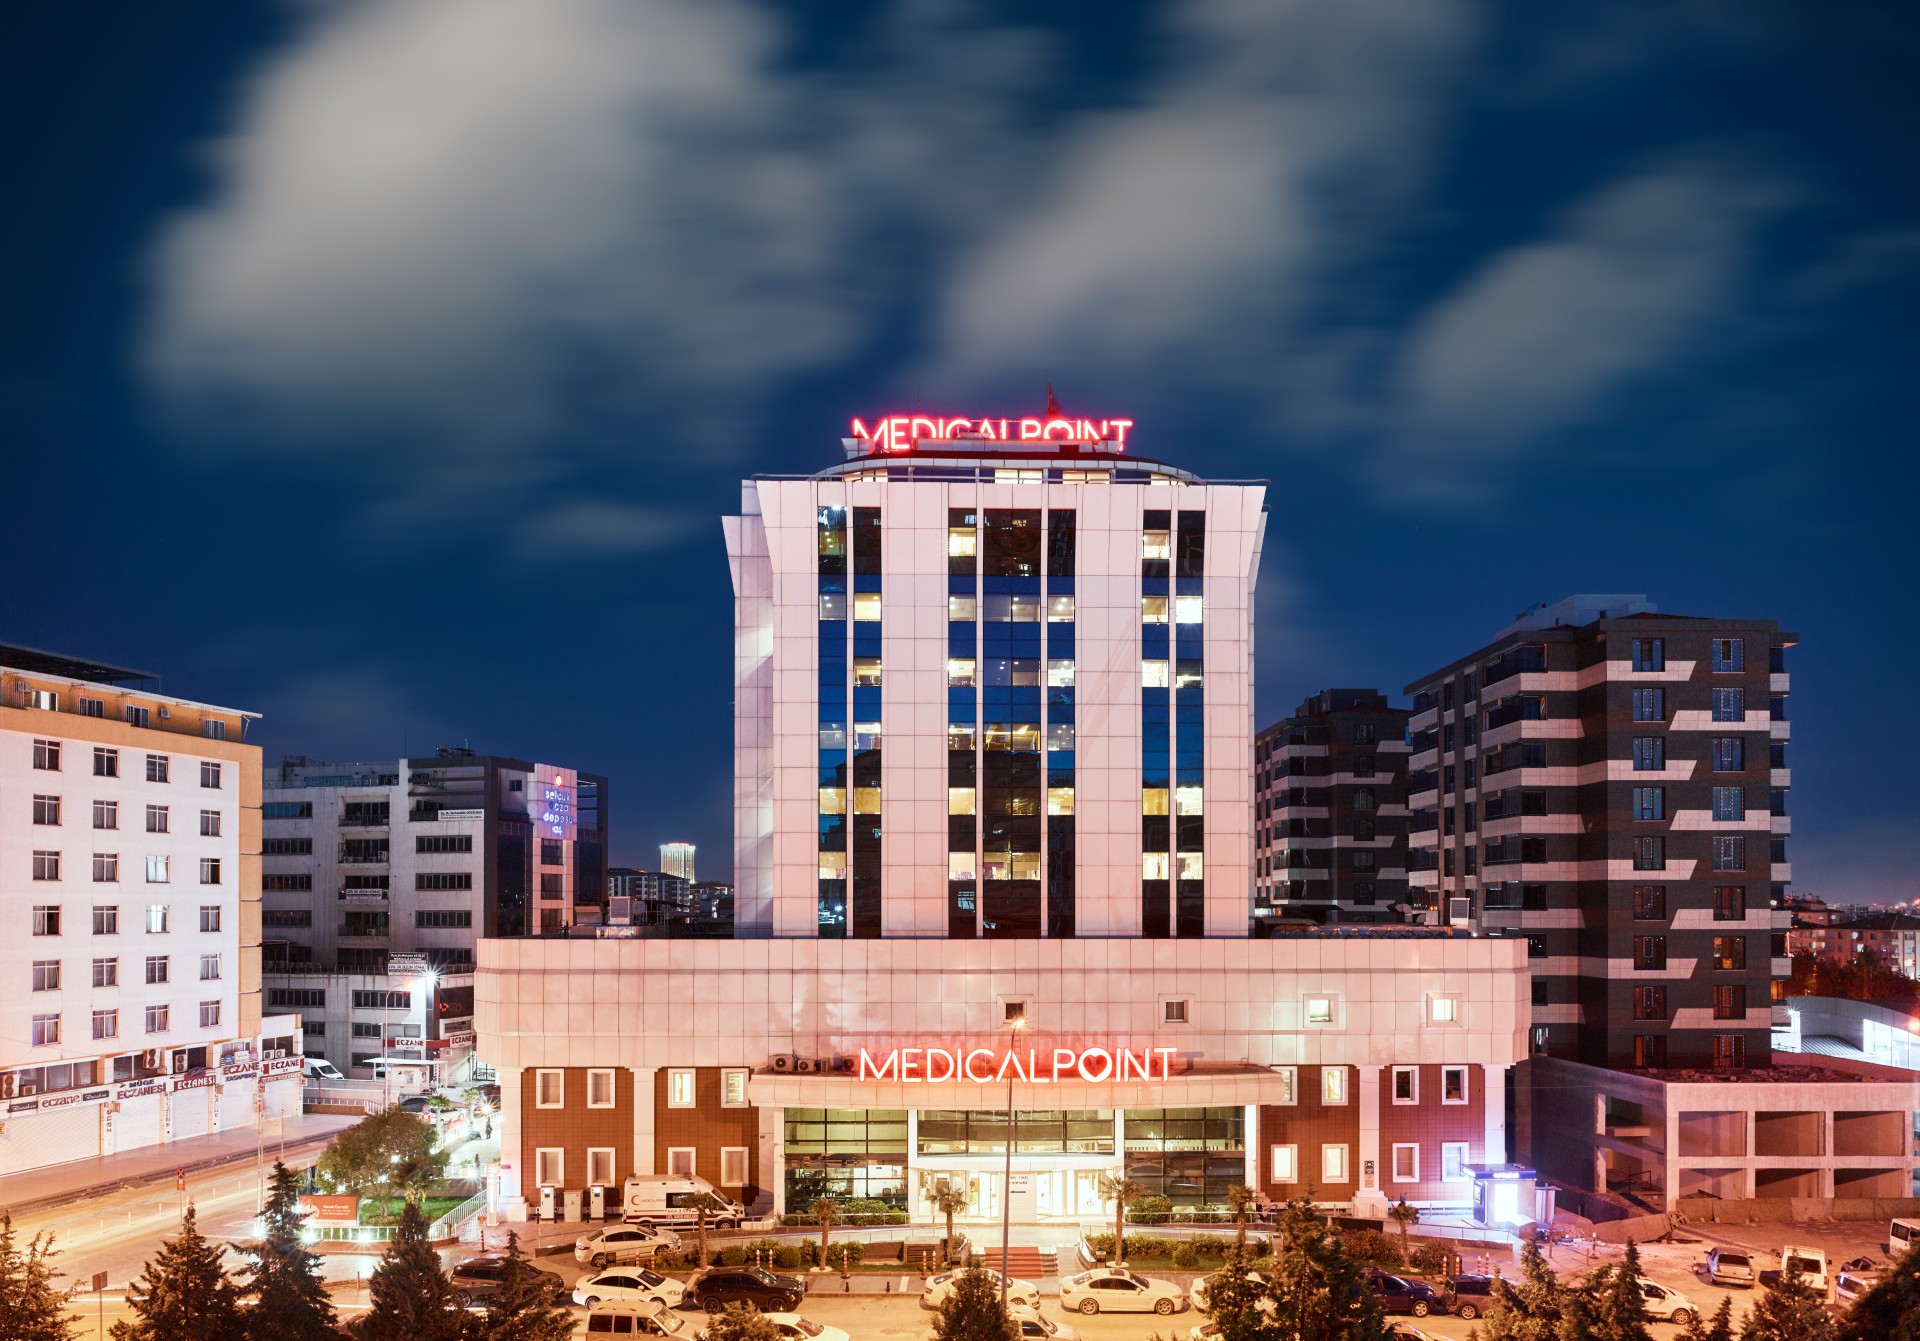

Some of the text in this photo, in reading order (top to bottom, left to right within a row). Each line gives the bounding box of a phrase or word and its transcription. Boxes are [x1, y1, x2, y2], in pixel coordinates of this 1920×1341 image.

[853, 417, 1134, 451] MEDICALPOINT
[545, 790, 571, 802] selçuk
[543, 811, 573, 824] deposu
[452, 1036, 472, 1044] ECZANE
[223, 1062, 259, 1076] ECZANE
[270, 1059, 300, 1070] ECZANE
[859, 1047, 1178, 1084] MEDICALPOINT
[129, 1079, 154, 1087] MÜGE
[41, 1094, 81, 1109] eczane
